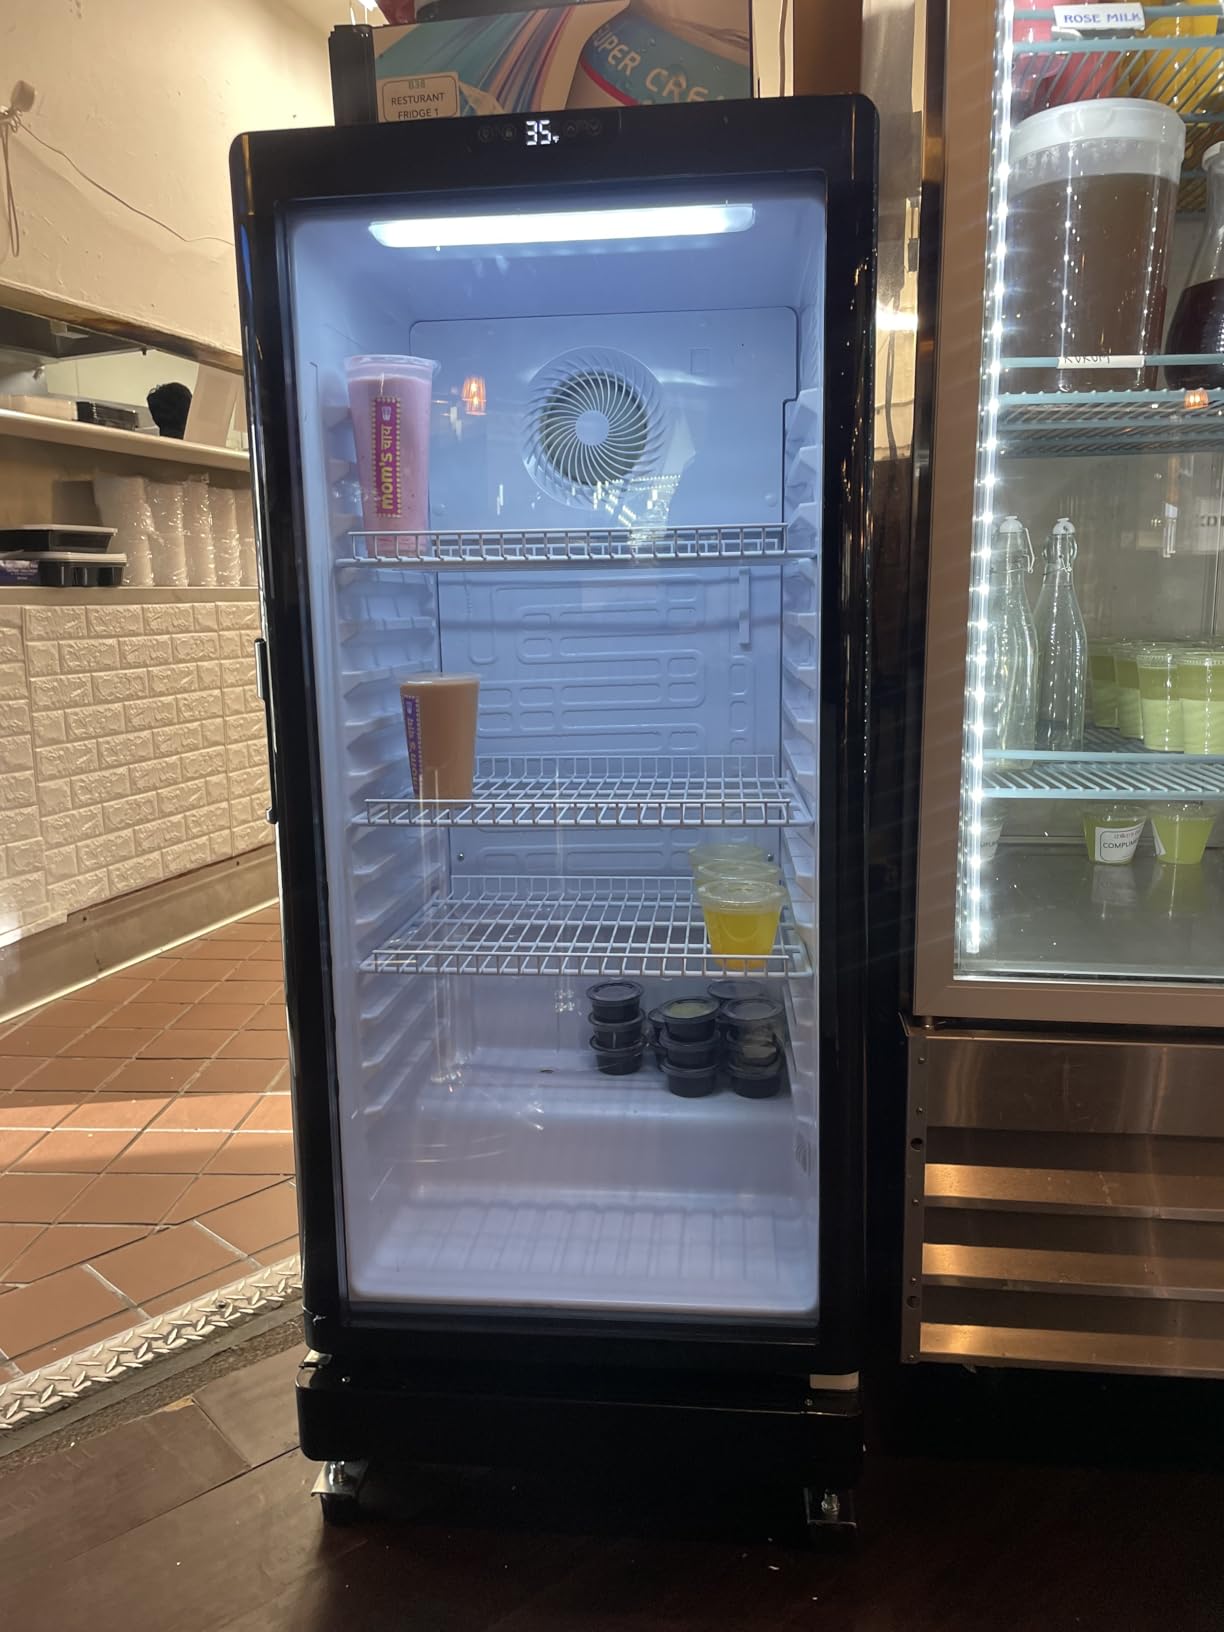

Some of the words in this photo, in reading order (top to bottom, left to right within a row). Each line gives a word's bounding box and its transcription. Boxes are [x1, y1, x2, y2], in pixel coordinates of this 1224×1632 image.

[1064, 14, 1100, 23] ROSE
[1106, 13, 1140, 22] MILK
[391, 92, 445, 106] RESTURANT
[398, 108, 432, 120] FRIDGE
[526, 119, 551, 146] 35
[379, 453, 394, 510] mom's
